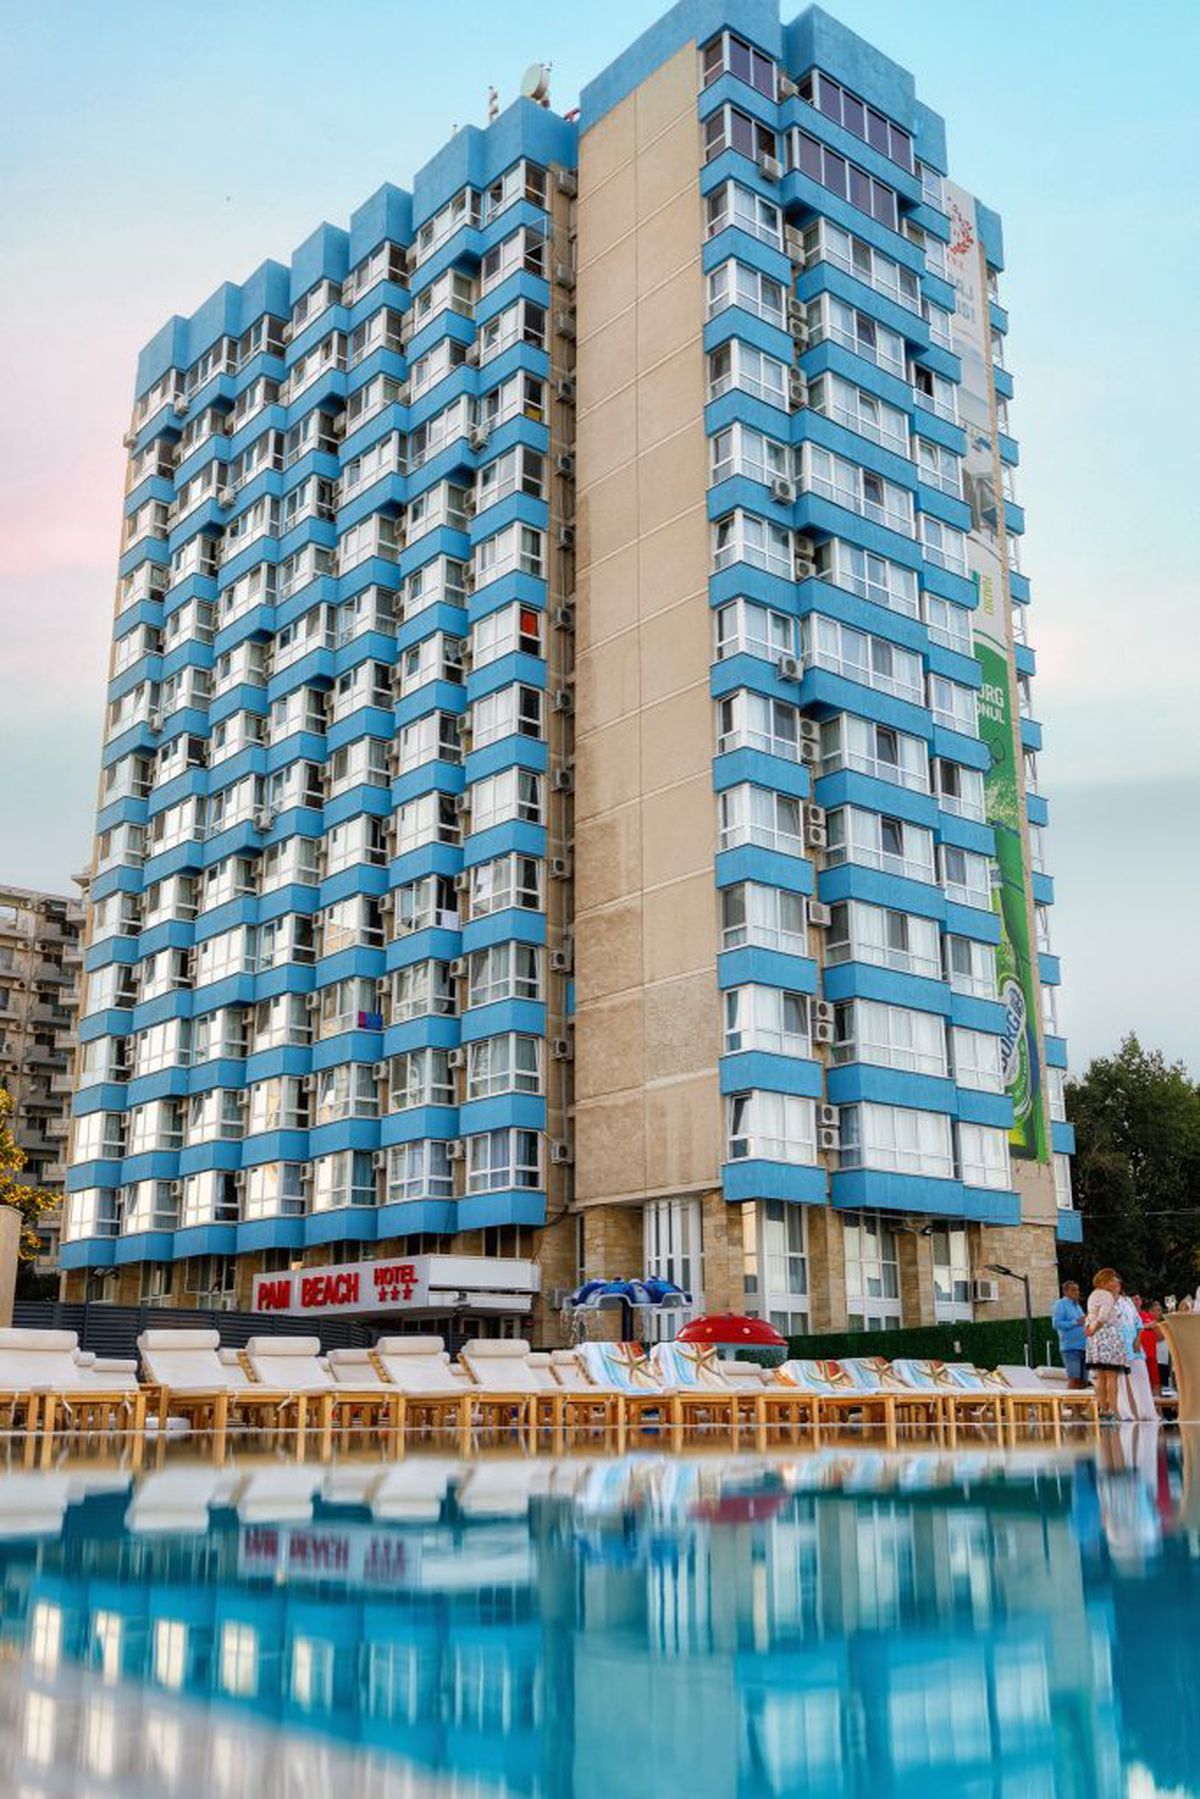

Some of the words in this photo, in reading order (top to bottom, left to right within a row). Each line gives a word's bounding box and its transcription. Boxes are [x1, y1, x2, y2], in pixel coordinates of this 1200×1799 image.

[258, 1281, 291, 1310] PAM
[302, 1273, 359, 1308] BEACH
[374, 1265, 418, 1286] HOTEL
